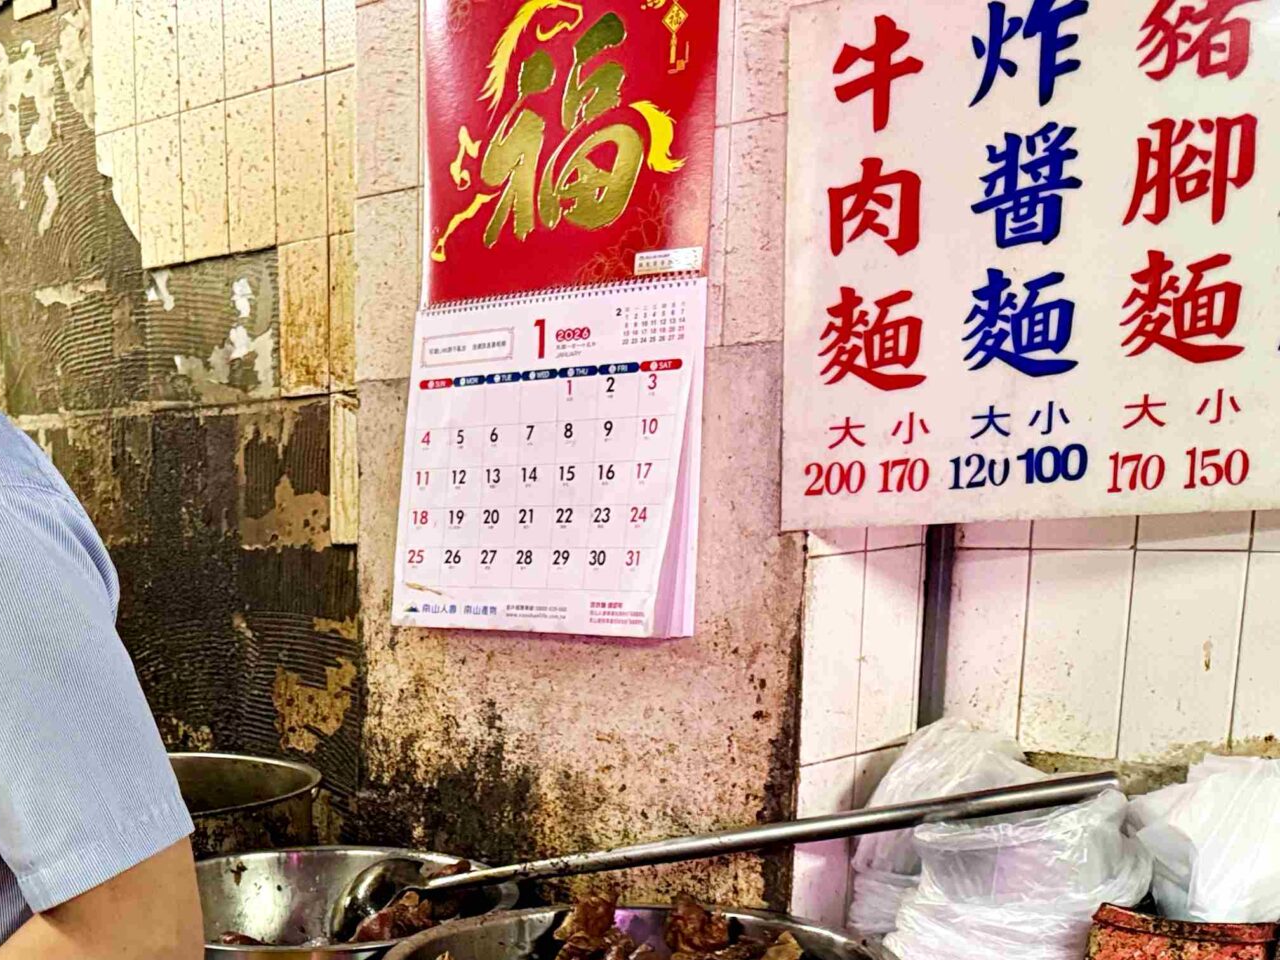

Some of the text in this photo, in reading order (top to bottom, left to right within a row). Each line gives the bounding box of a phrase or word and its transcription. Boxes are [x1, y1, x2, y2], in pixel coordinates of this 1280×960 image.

[480, 12, 645, 248] 福
[962, 0, 1089, 377] 炸醬麵
[1119, 0, 1260, 363] 豬腳麵
[818, 15, 927, 391] 牛肉麵
[534, 319, 546, 359] 1
[556, 328, 590, 341] 2026
[566, 373, 658, 395] 1 2 3
[659, 361, 672, 369] SAT
[970, 401, 1070, 440] 大 小
[1122, 388, 1241, 430] 大 小
[421, 418, 659, 445] 4 5 6 7 8 9 10
[827, 412, 930, 450] 大 小
[416, 463, 653, 485] 11 12 13 14 15 16 17
[804, 458, 930, 496] 200 170
[948, 443, 1088, 490] 120 100
[1107, 446, 1250, 493] 170 150
[412, 507, 647, 524] 18 19 20 21 22 23 24
[407, 550, 641, 566] 25 26 27 28 29 30 31
